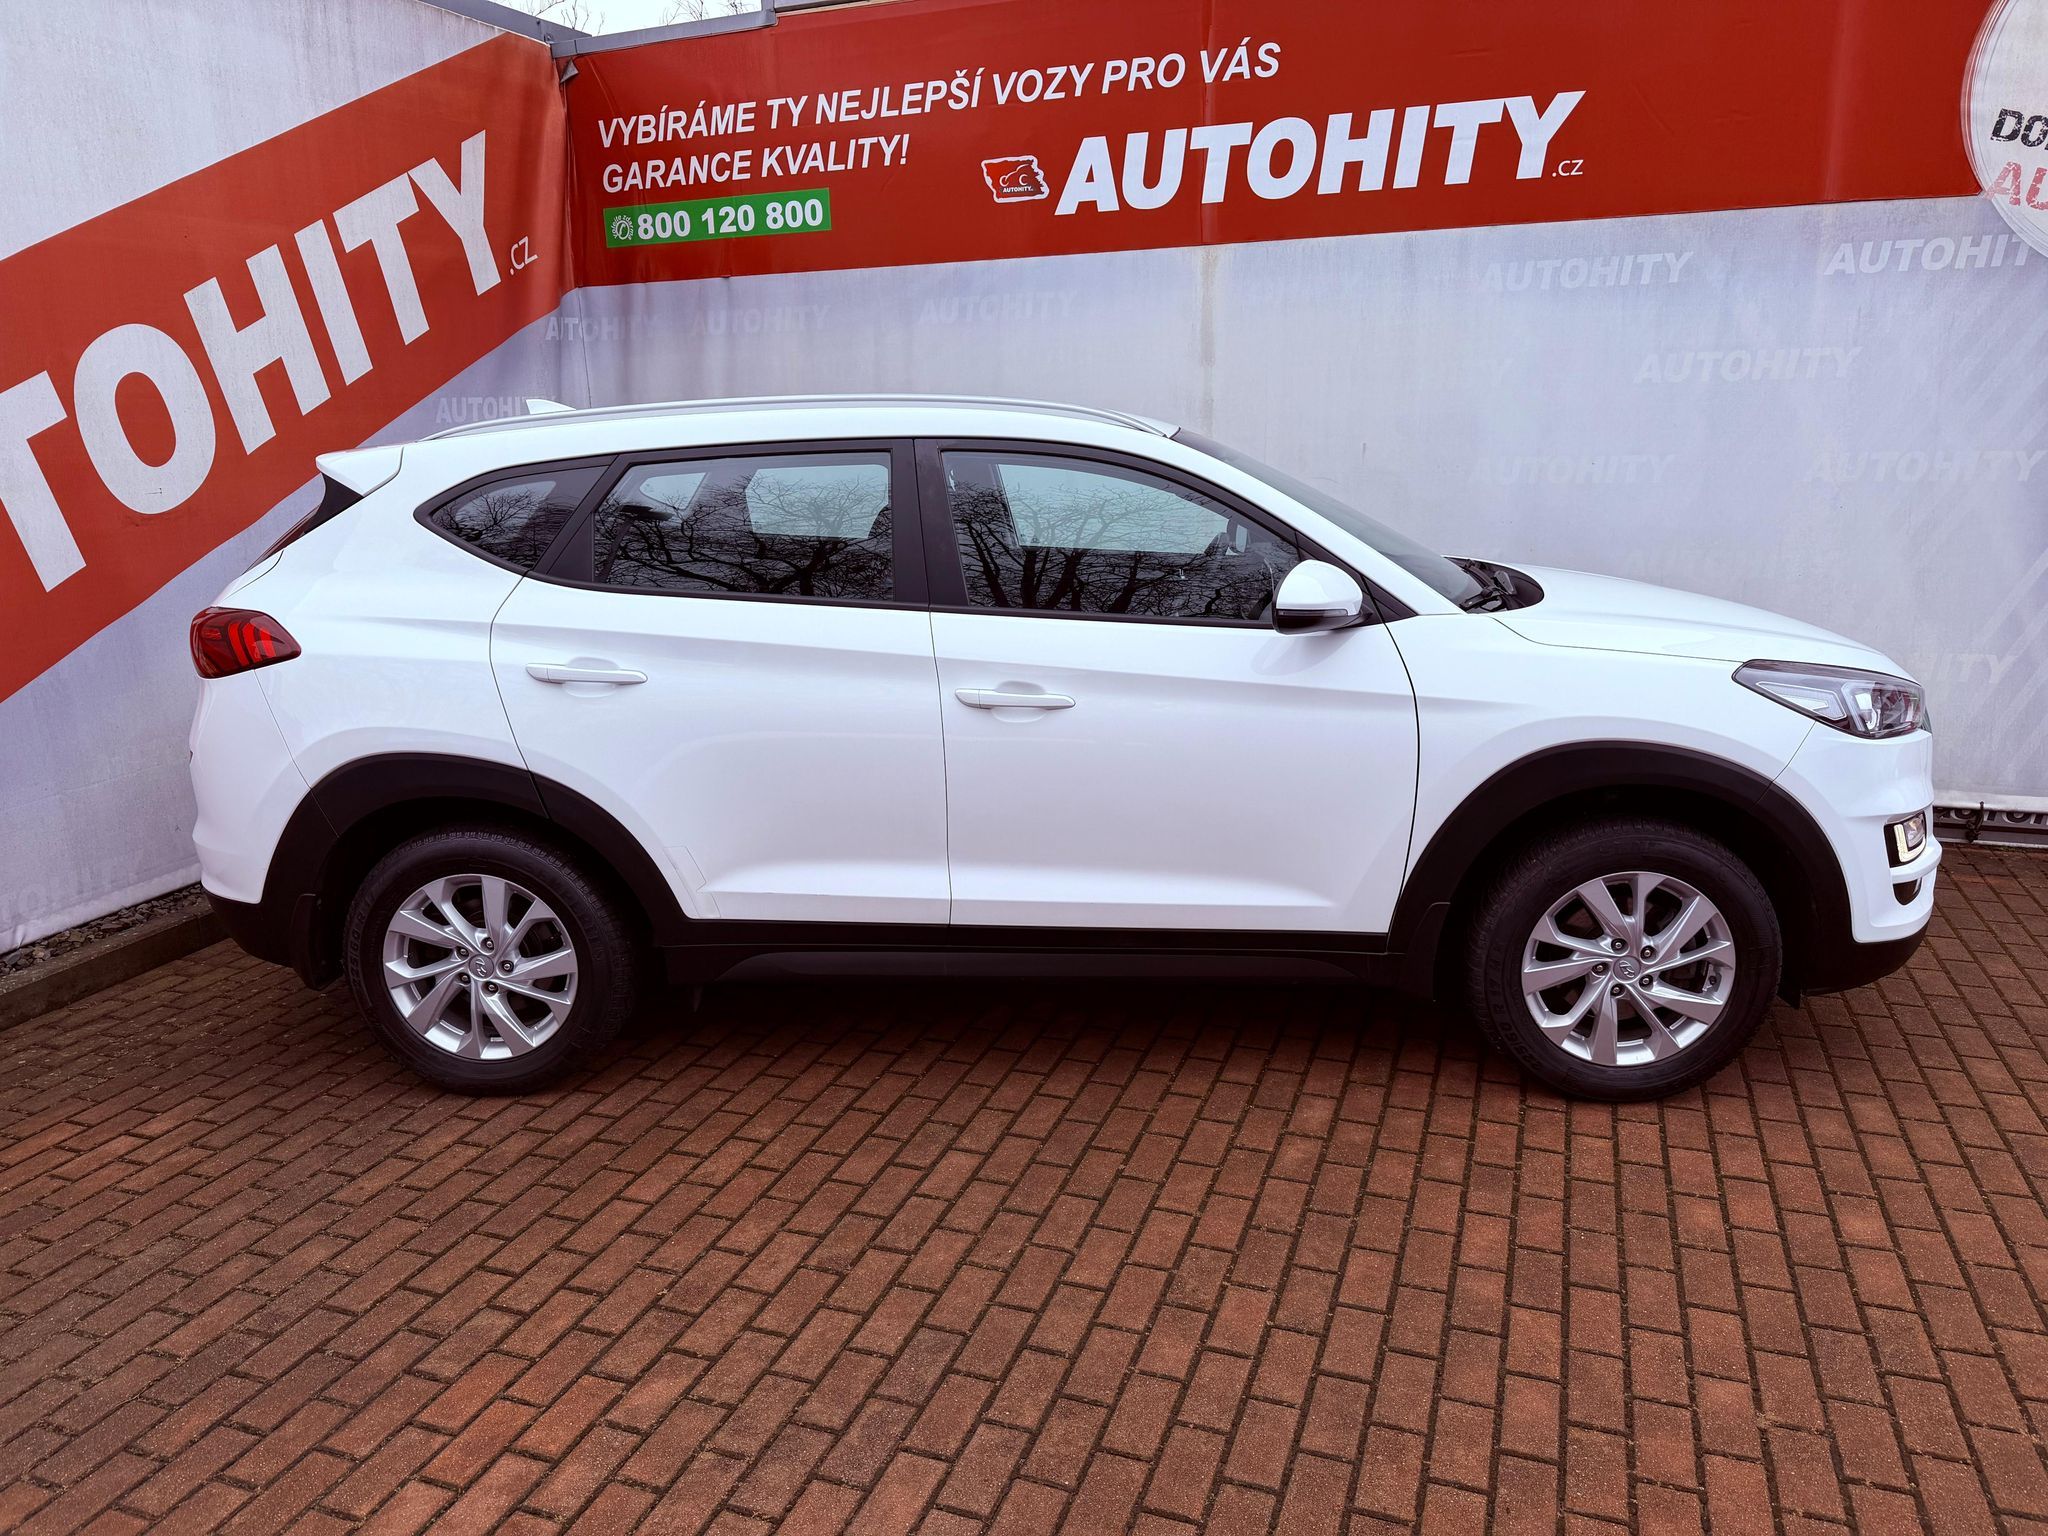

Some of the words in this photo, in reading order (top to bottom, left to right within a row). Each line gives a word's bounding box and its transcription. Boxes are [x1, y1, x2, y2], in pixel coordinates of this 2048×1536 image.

[598, 100, 757, 148] VYBÍRÁME
[766, 95, 809, 130] TY
[815, 67, 985, 125] NEJLEPŠÍ
[992, 62, 1095, 105] VOZY
[1101, 52, 1186, 95] PRO
[1199, 36, 1282, 84] VÁS
[1990, 107, 2048, 150] DO
[603, 149, 753, 193] GARANCE
[761, 133, 910, 178] KVALITY!
[1054, 90, 1587, 216] AUTOHITY
[637, 210, 691, 240] 800
[701, 204, 756, 235] 120
[765, 198, 824, 230] 800
[1484, 251, 1694, 291] AUTOHITY
[1823, 233, 2034, 276] AUTOHIT
[1633, 346, 1862, 385] AUTOHITY
